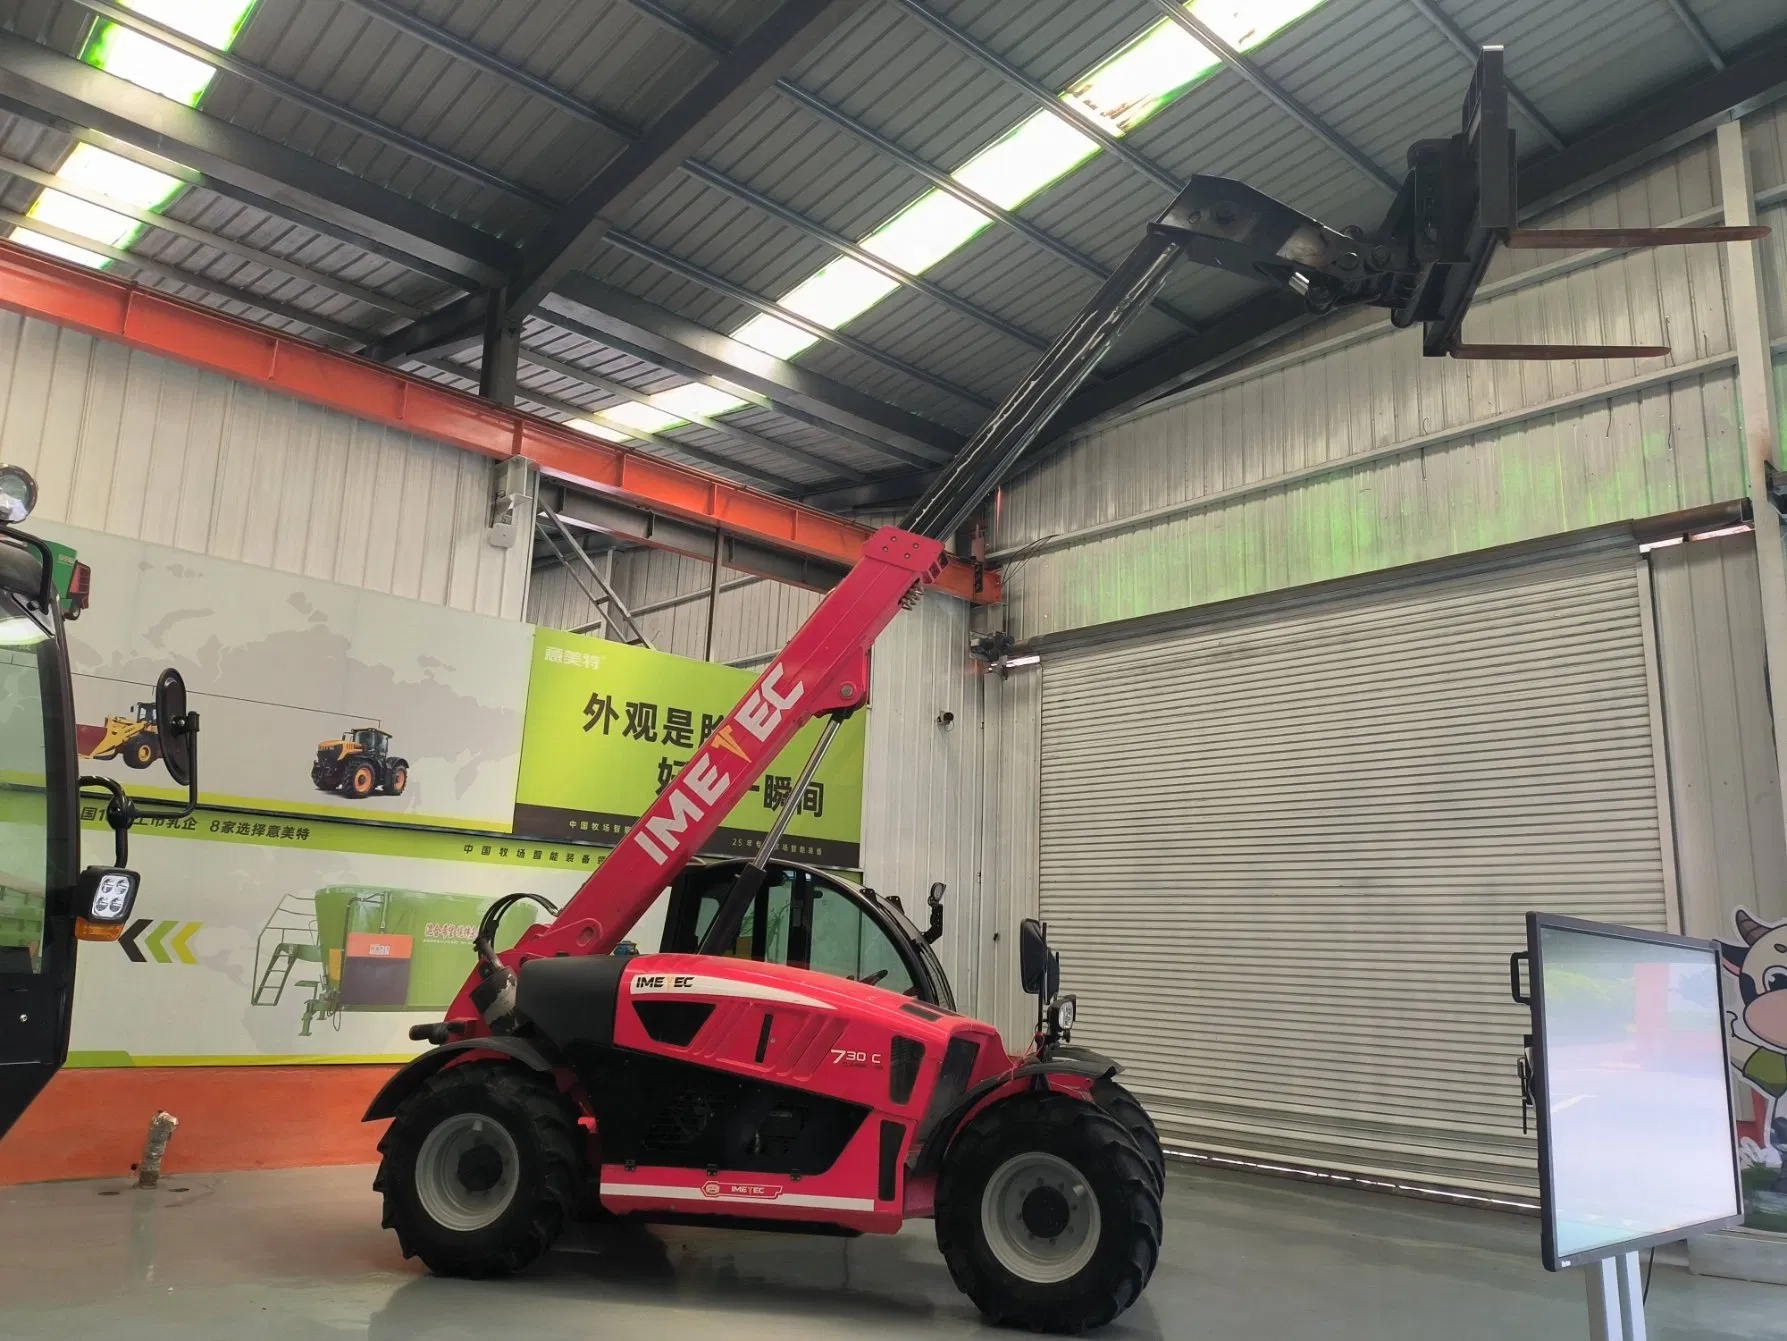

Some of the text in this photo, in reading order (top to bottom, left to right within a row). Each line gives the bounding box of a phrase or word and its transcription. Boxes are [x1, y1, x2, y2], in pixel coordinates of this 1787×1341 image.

[545, 646, 600, 670] 意美特
[209, 819, 310, 841] 8家选择意美特
[830, 1049, 882, 1064] 730 C
